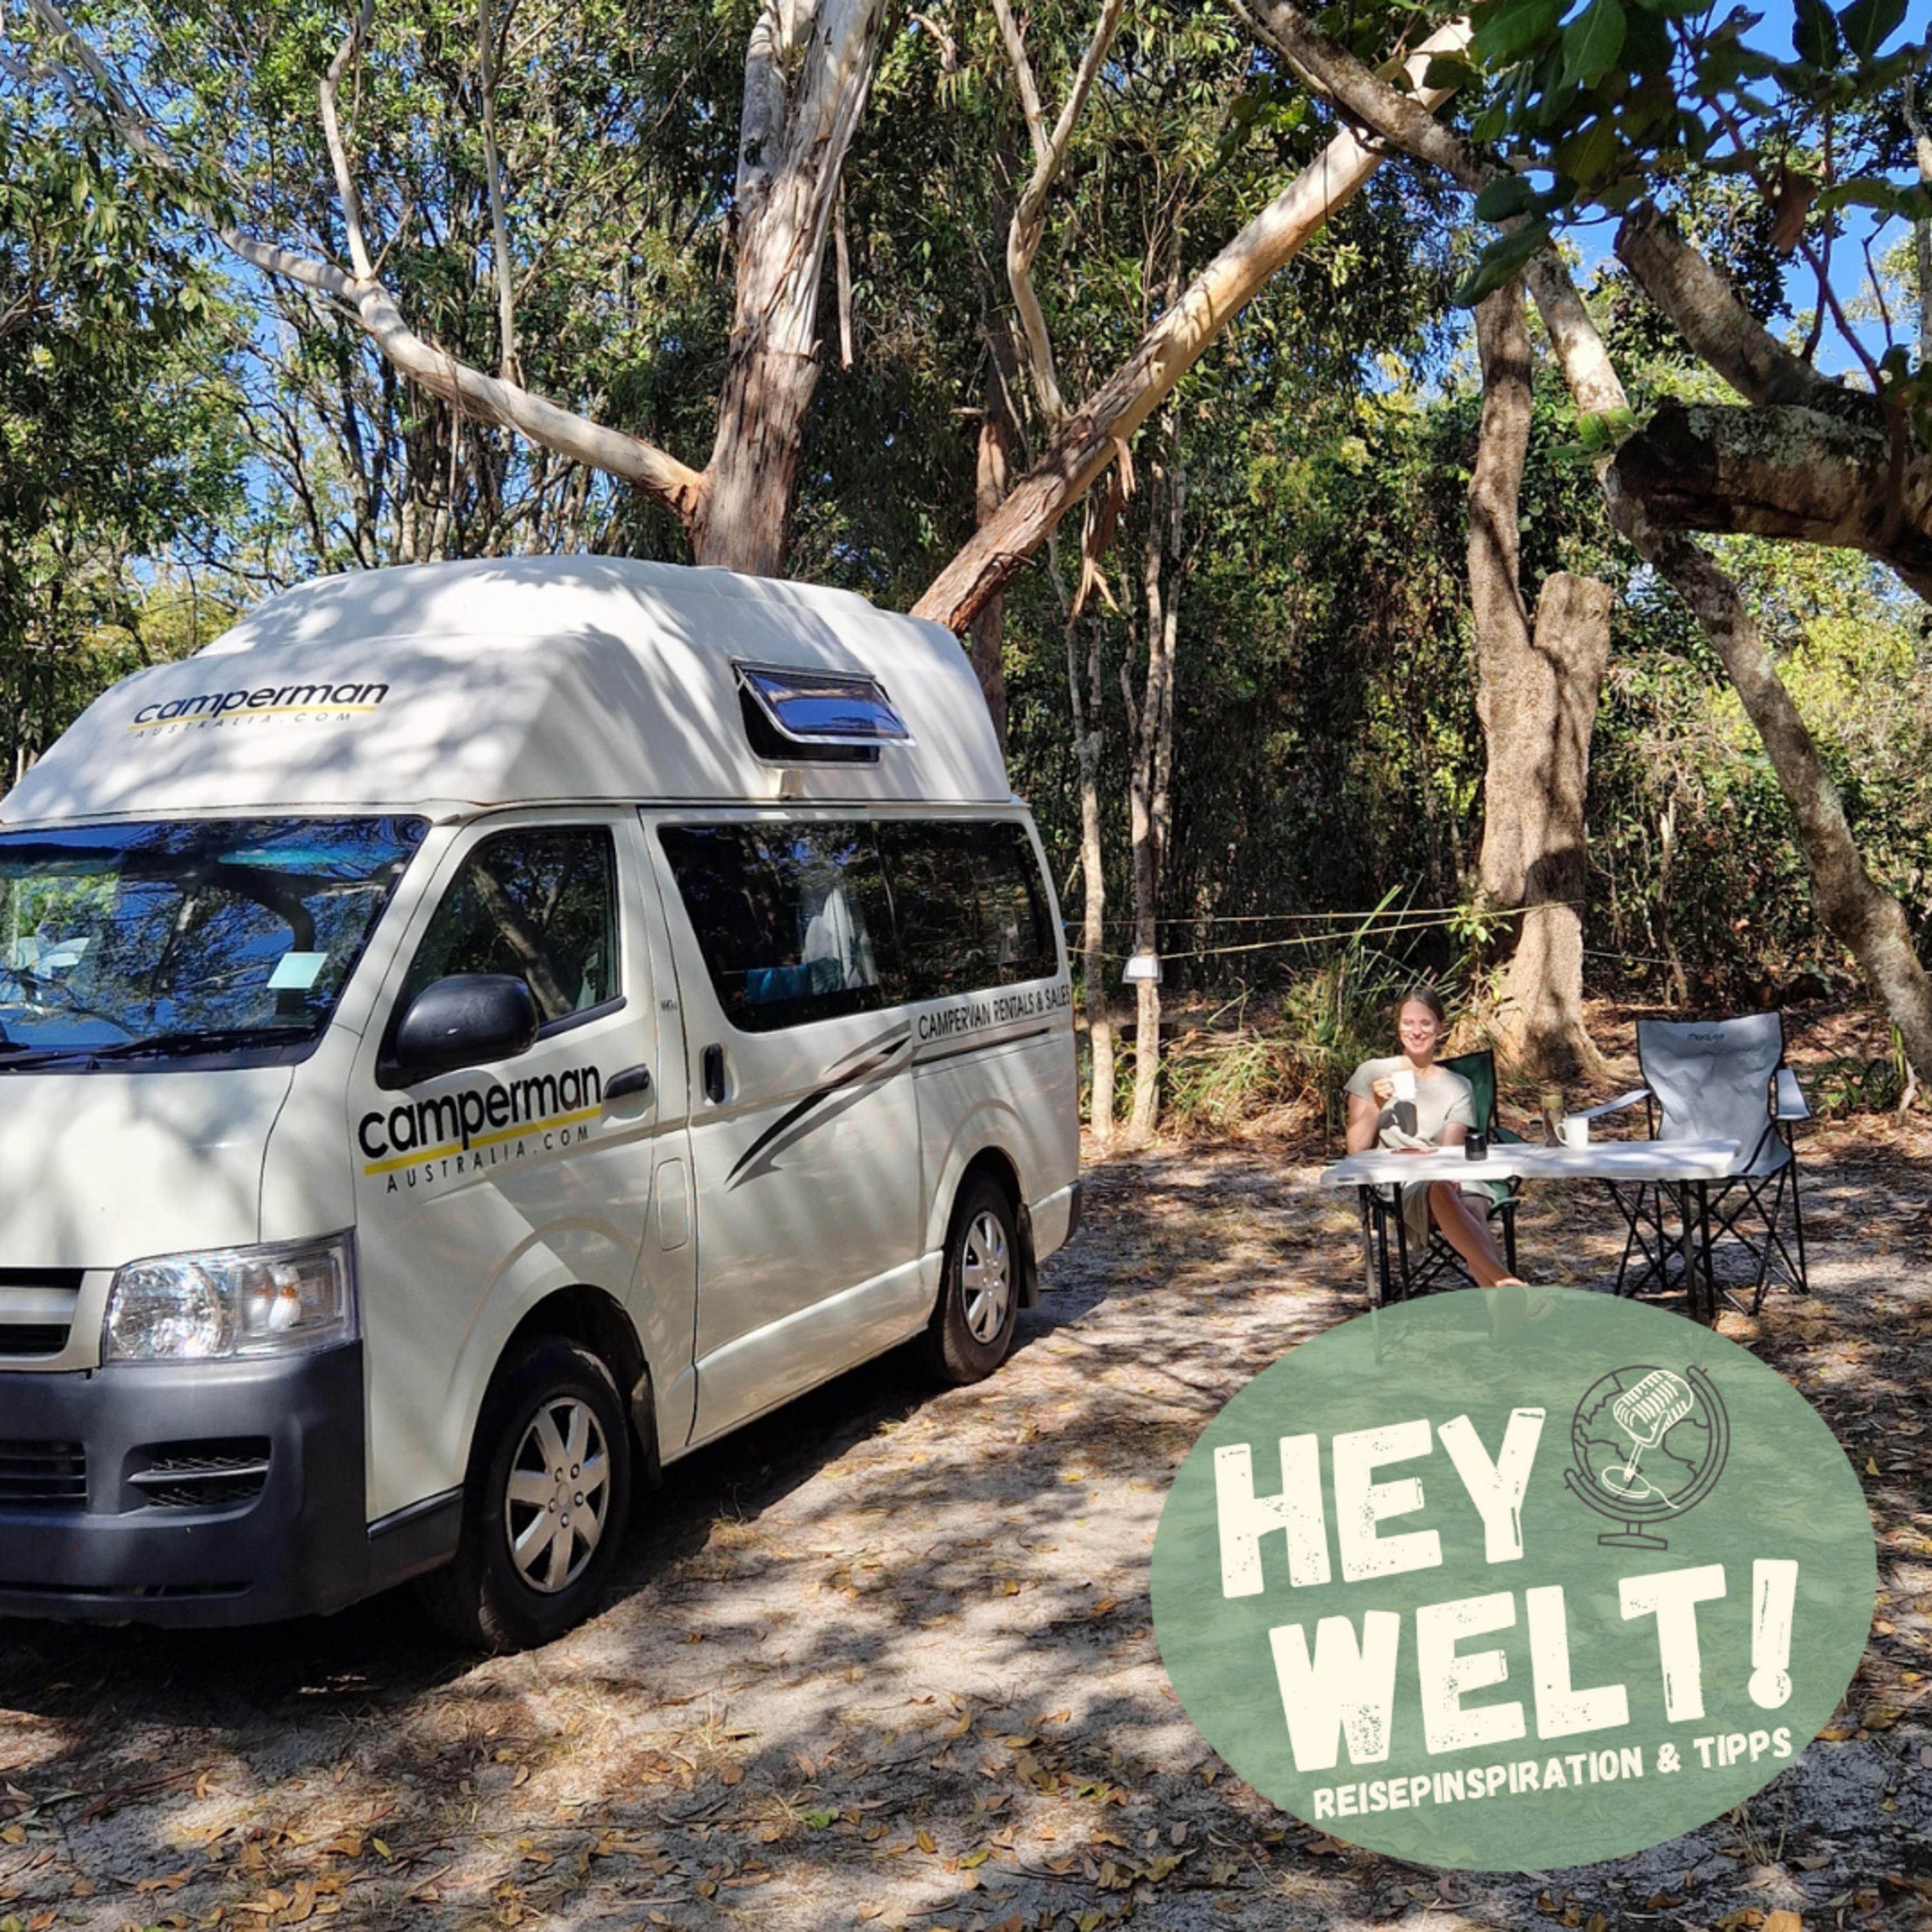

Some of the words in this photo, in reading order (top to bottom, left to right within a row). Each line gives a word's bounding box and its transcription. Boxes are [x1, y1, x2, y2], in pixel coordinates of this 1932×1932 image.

[134, 683, 389, 724] camperman
[918, 1001, 990, 1040] CAMPERVAN
[993, 993, 1034, 1023] RENTALS
[1036, 990, 1043, 1012] &
[1045, 983, 1070, 1010] SALES
[358, 1065, 601, 1159] camperman
